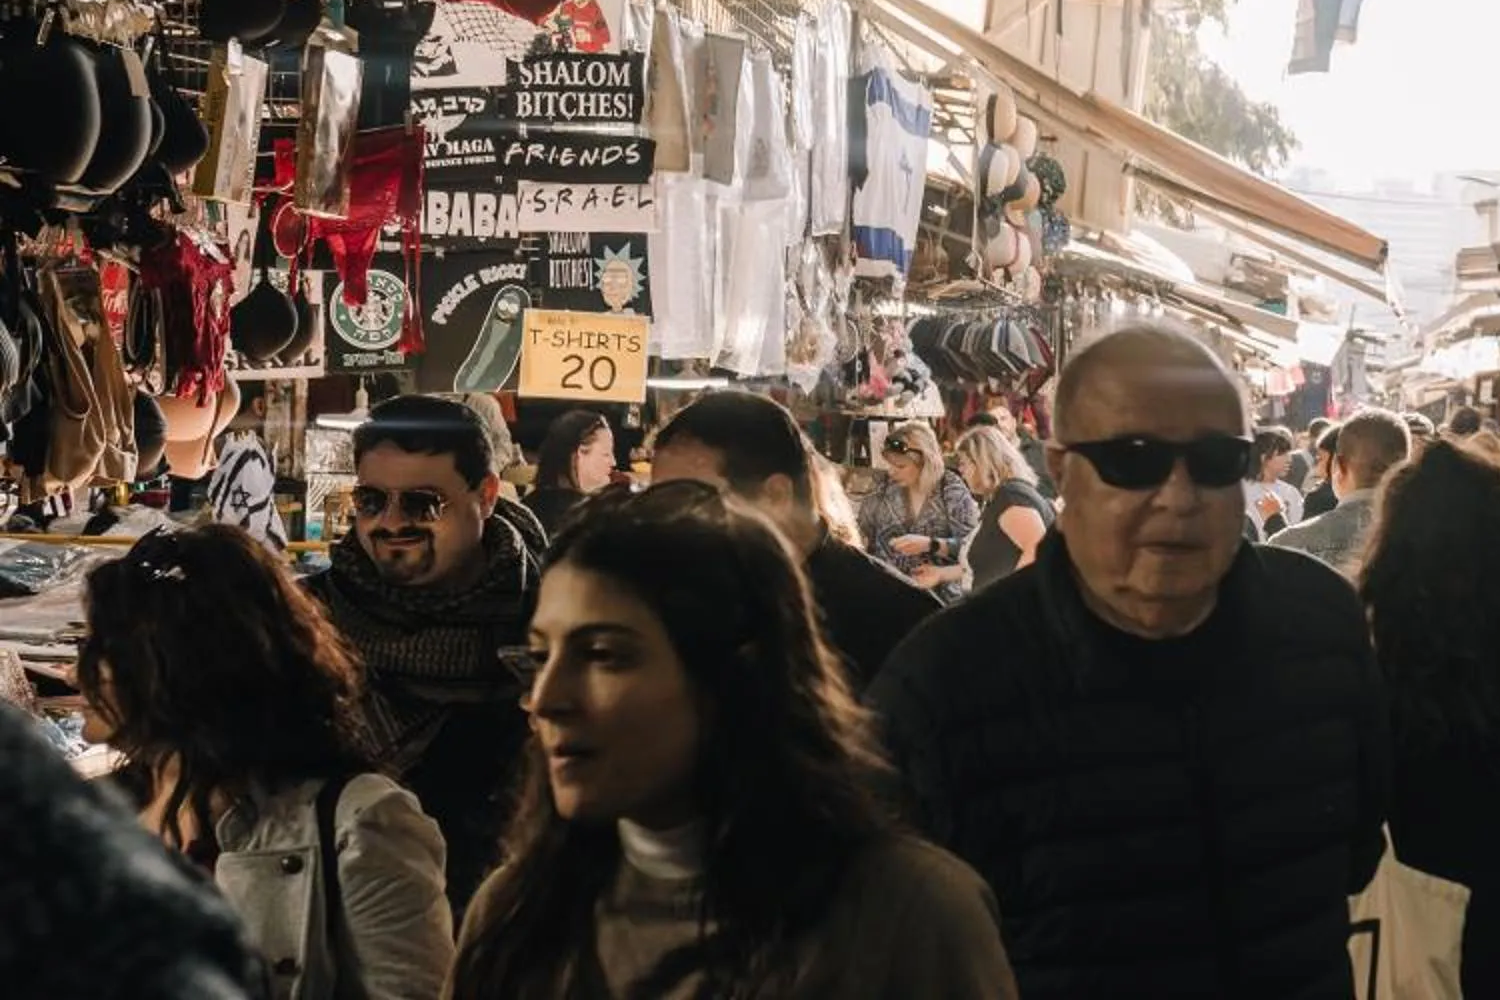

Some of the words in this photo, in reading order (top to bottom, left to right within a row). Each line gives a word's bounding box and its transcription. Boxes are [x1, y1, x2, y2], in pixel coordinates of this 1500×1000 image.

[519, 61, 631, 88] SHALOM
[410, 97, 437, 114] מג
[443, 95, 486, 113] קרב
[516, 91, 633, 120] BITCHES!
[530, 328, 641, 352] T-SHIRTS
[561, 354, 617, 391] 20
